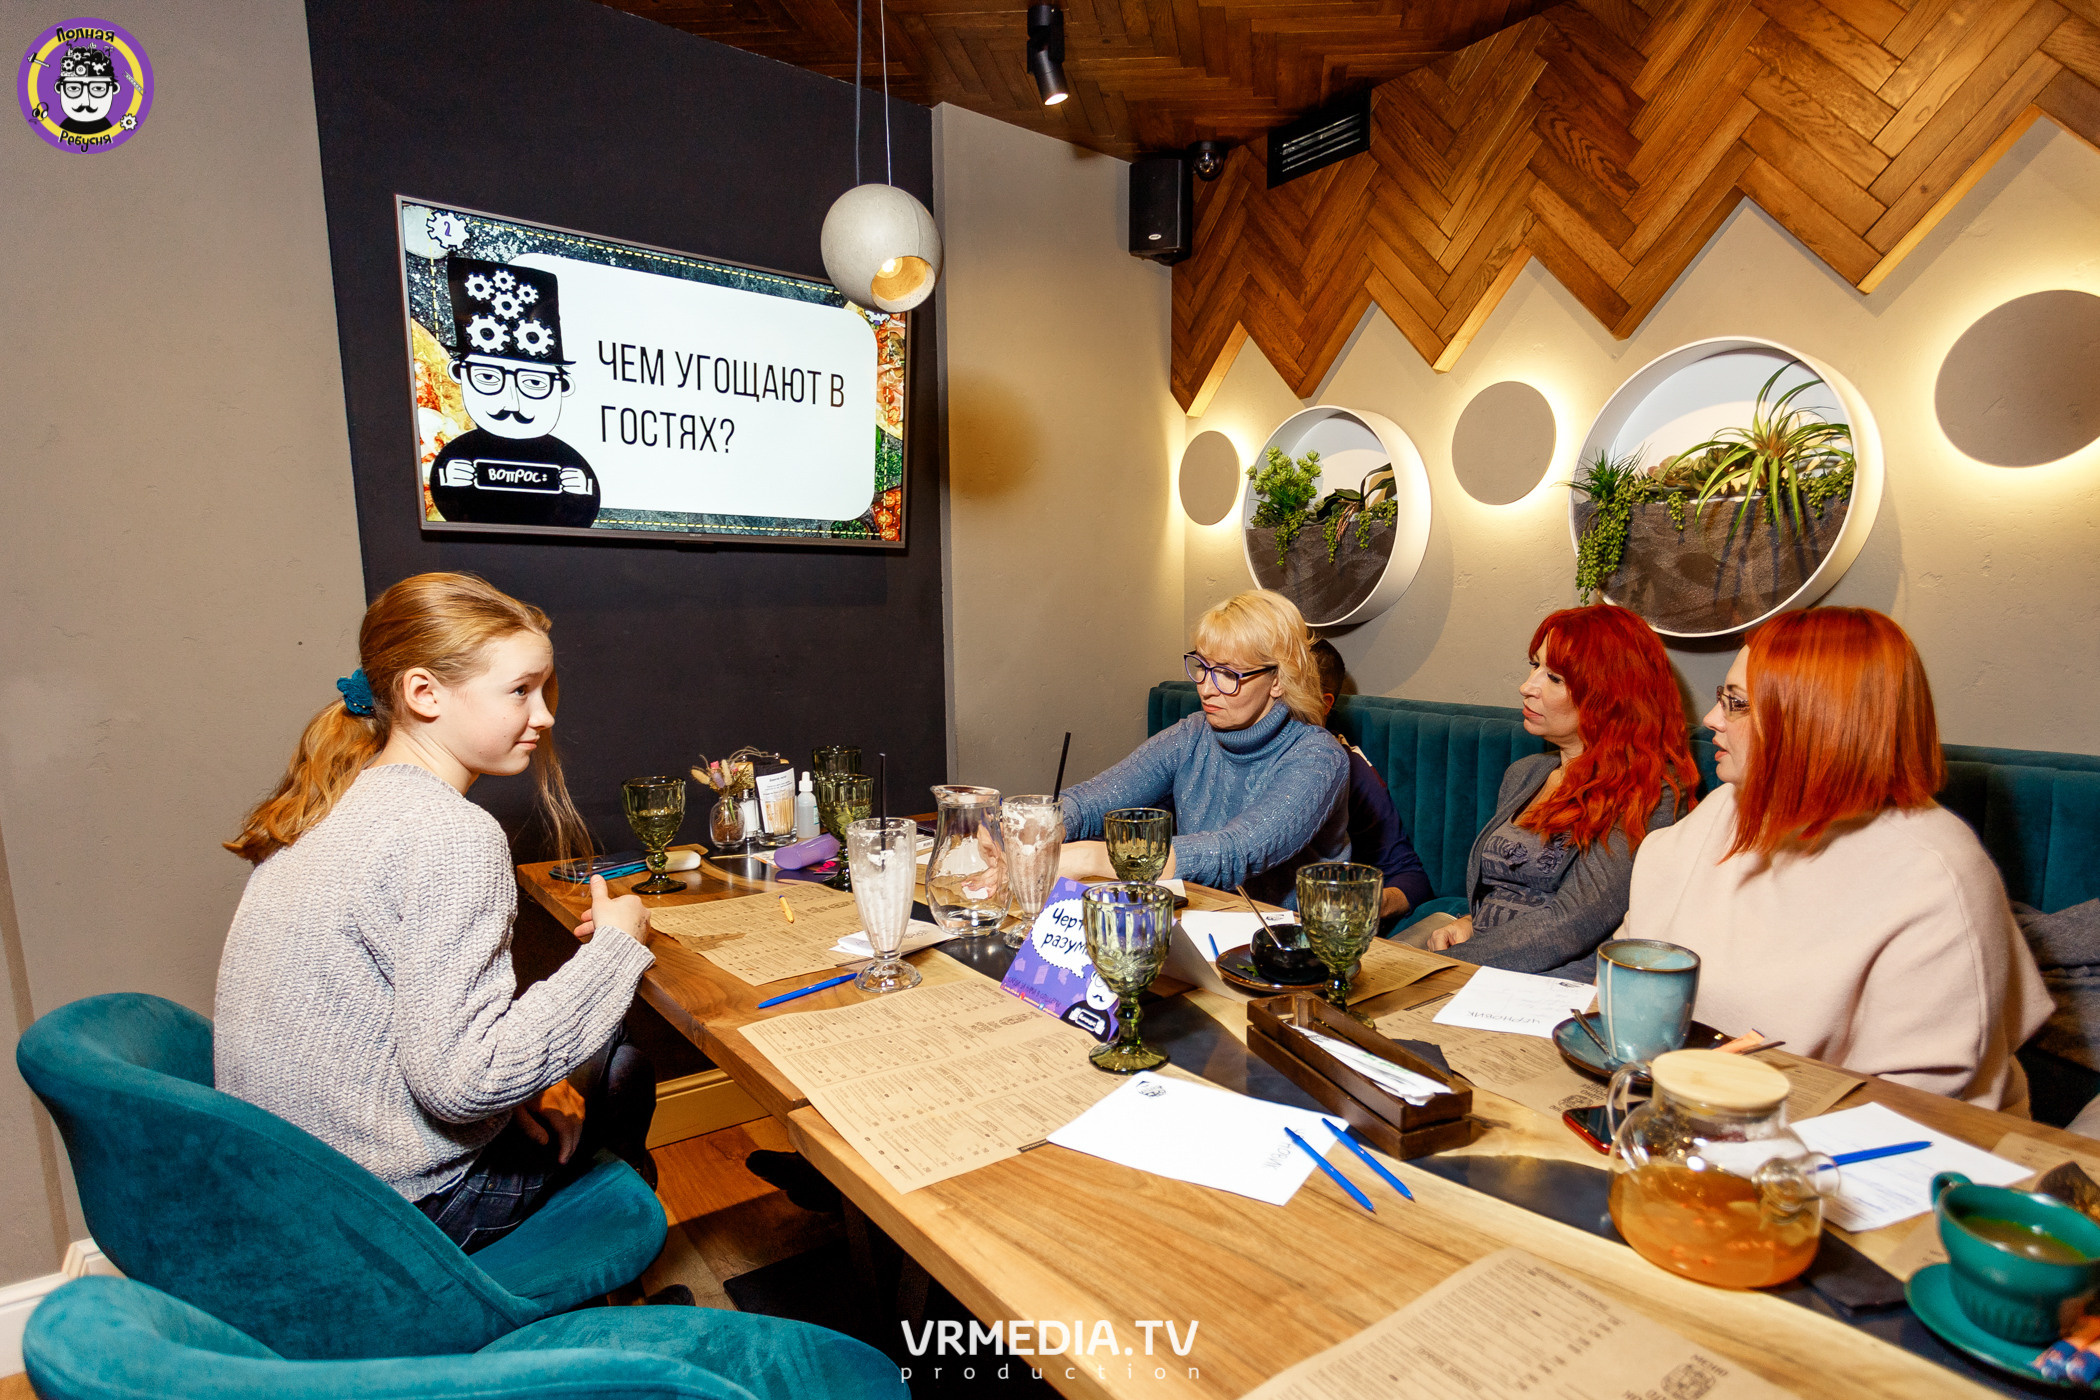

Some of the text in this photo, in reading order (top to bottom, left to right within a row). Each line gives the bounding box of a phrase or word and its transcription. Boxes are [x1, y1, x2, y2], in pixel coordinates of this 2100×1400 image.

[598, 340, 845, 408] ЧЕМ УГОЩАЮТ В
[601, 405, 735, 453] ГОСТЯХ?
[488, 468, 548, 483] ВОПРОС:
[1052, 907, 1084, 932] Черт
[1040, 933, 1088, 955] разум
